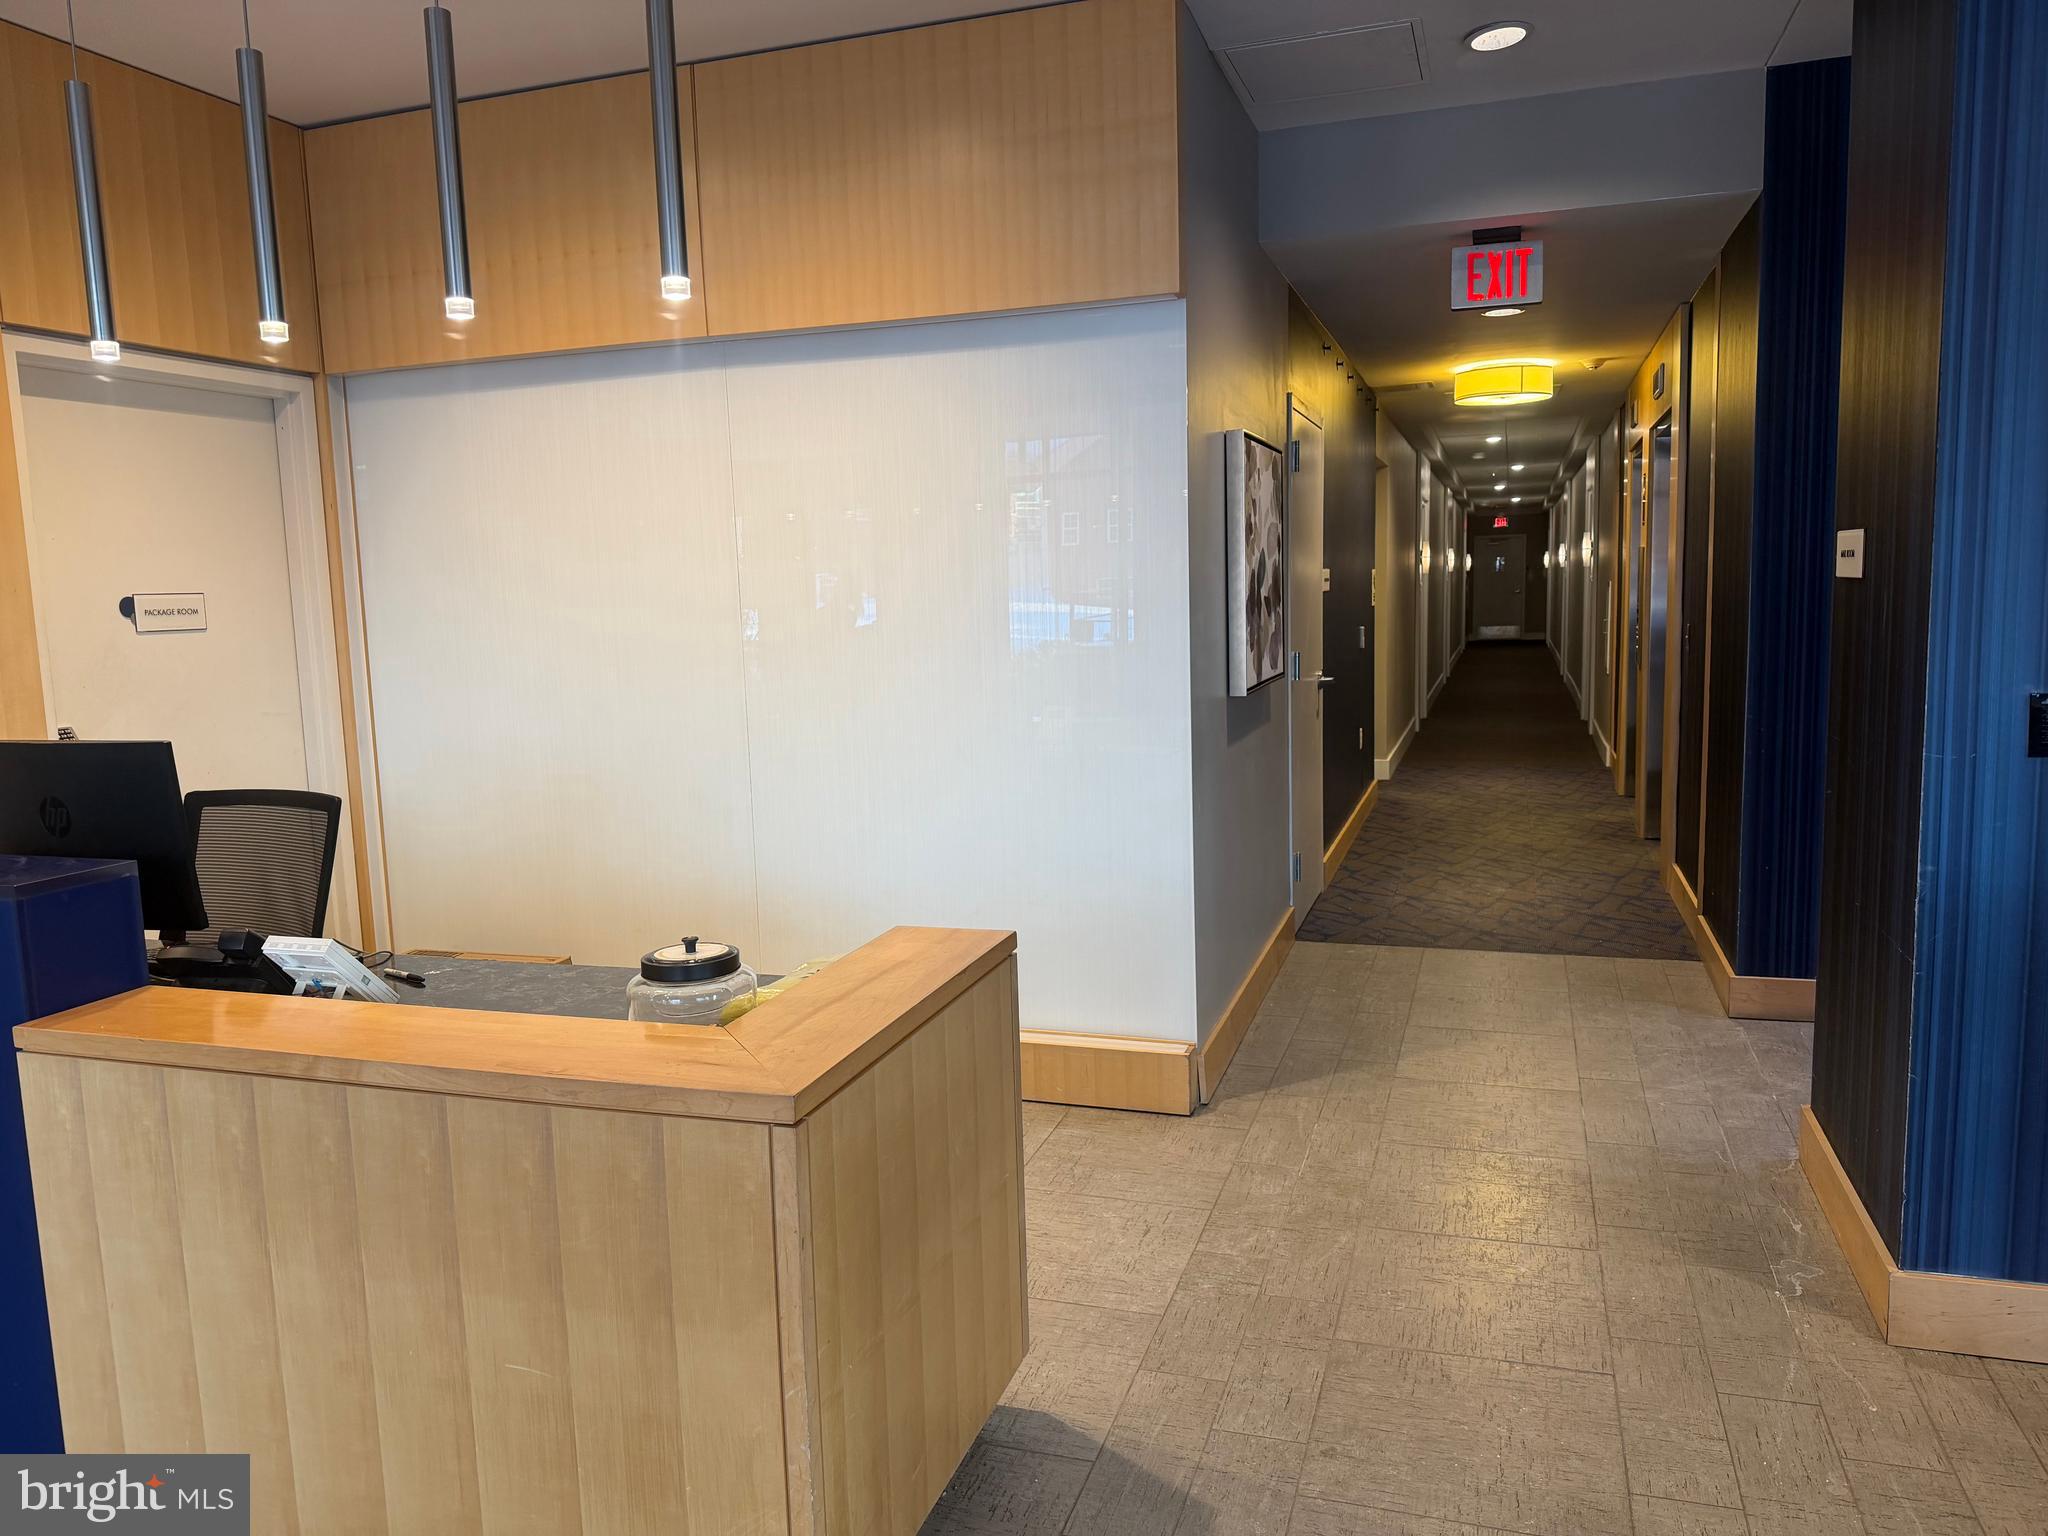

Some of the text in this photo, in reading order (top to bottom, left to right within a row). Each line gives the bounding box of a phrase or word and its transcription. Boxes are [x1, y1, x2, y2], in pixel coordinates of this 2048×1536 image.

[1466, 247, 1534, 302] EXIT
[144, 608, 199, 616] PACKAGE ROOM
[44, 796, 70, 839] hp
